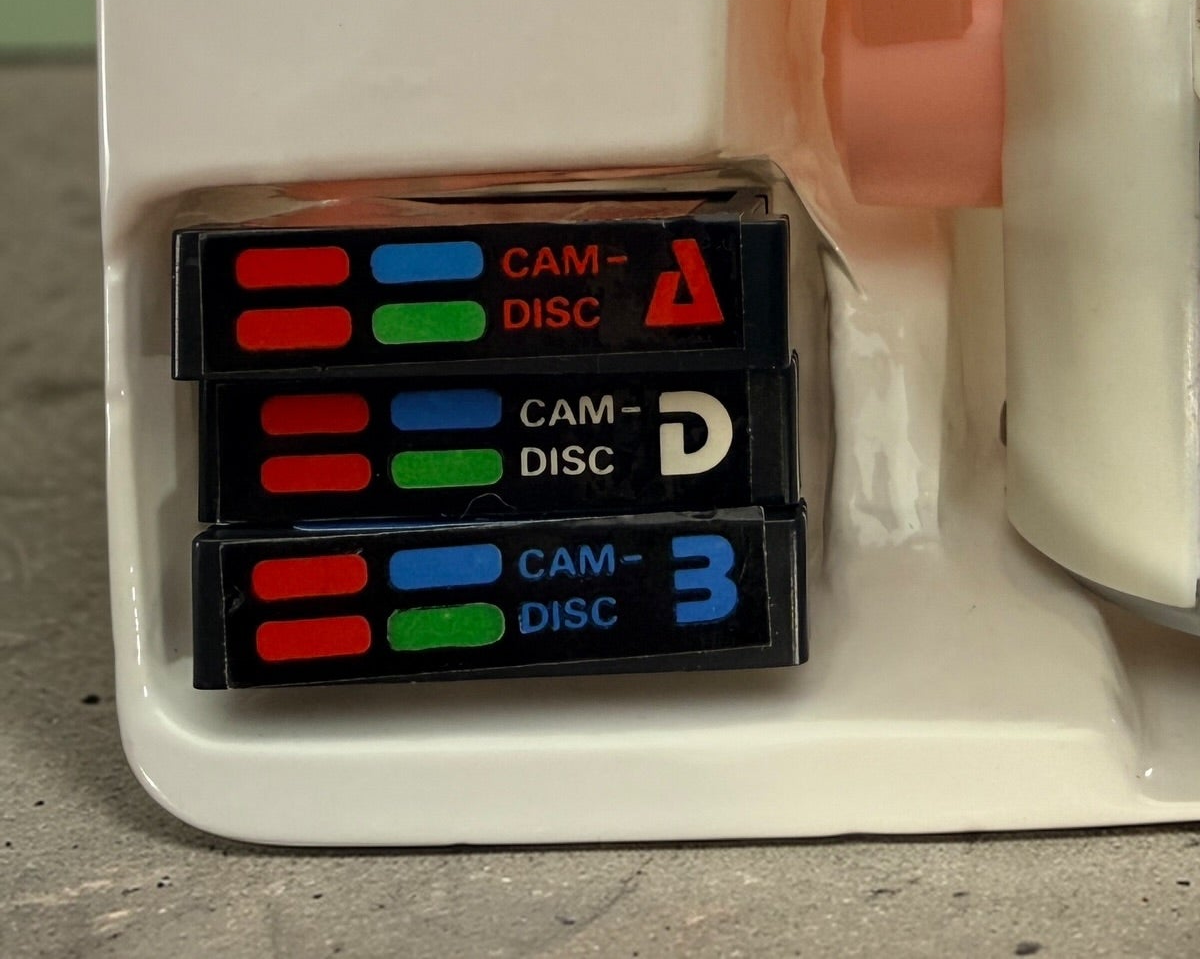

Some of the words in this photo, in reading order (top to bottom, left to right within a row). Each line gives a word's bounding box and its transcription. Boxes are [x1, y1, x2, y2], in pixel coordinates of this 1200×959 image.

[502, 245, 627, 278] CAM-
[644, 238, 725, 327] A
[503, 297, 602, 330] DISC
[519, 394, 642, 428] CAM-
[658, 390, 734, 476] D
[519, 446, 616, 478] DISC
[519, 544, 642, 578] CAM-
[519, 597, 618, 634] DISC
